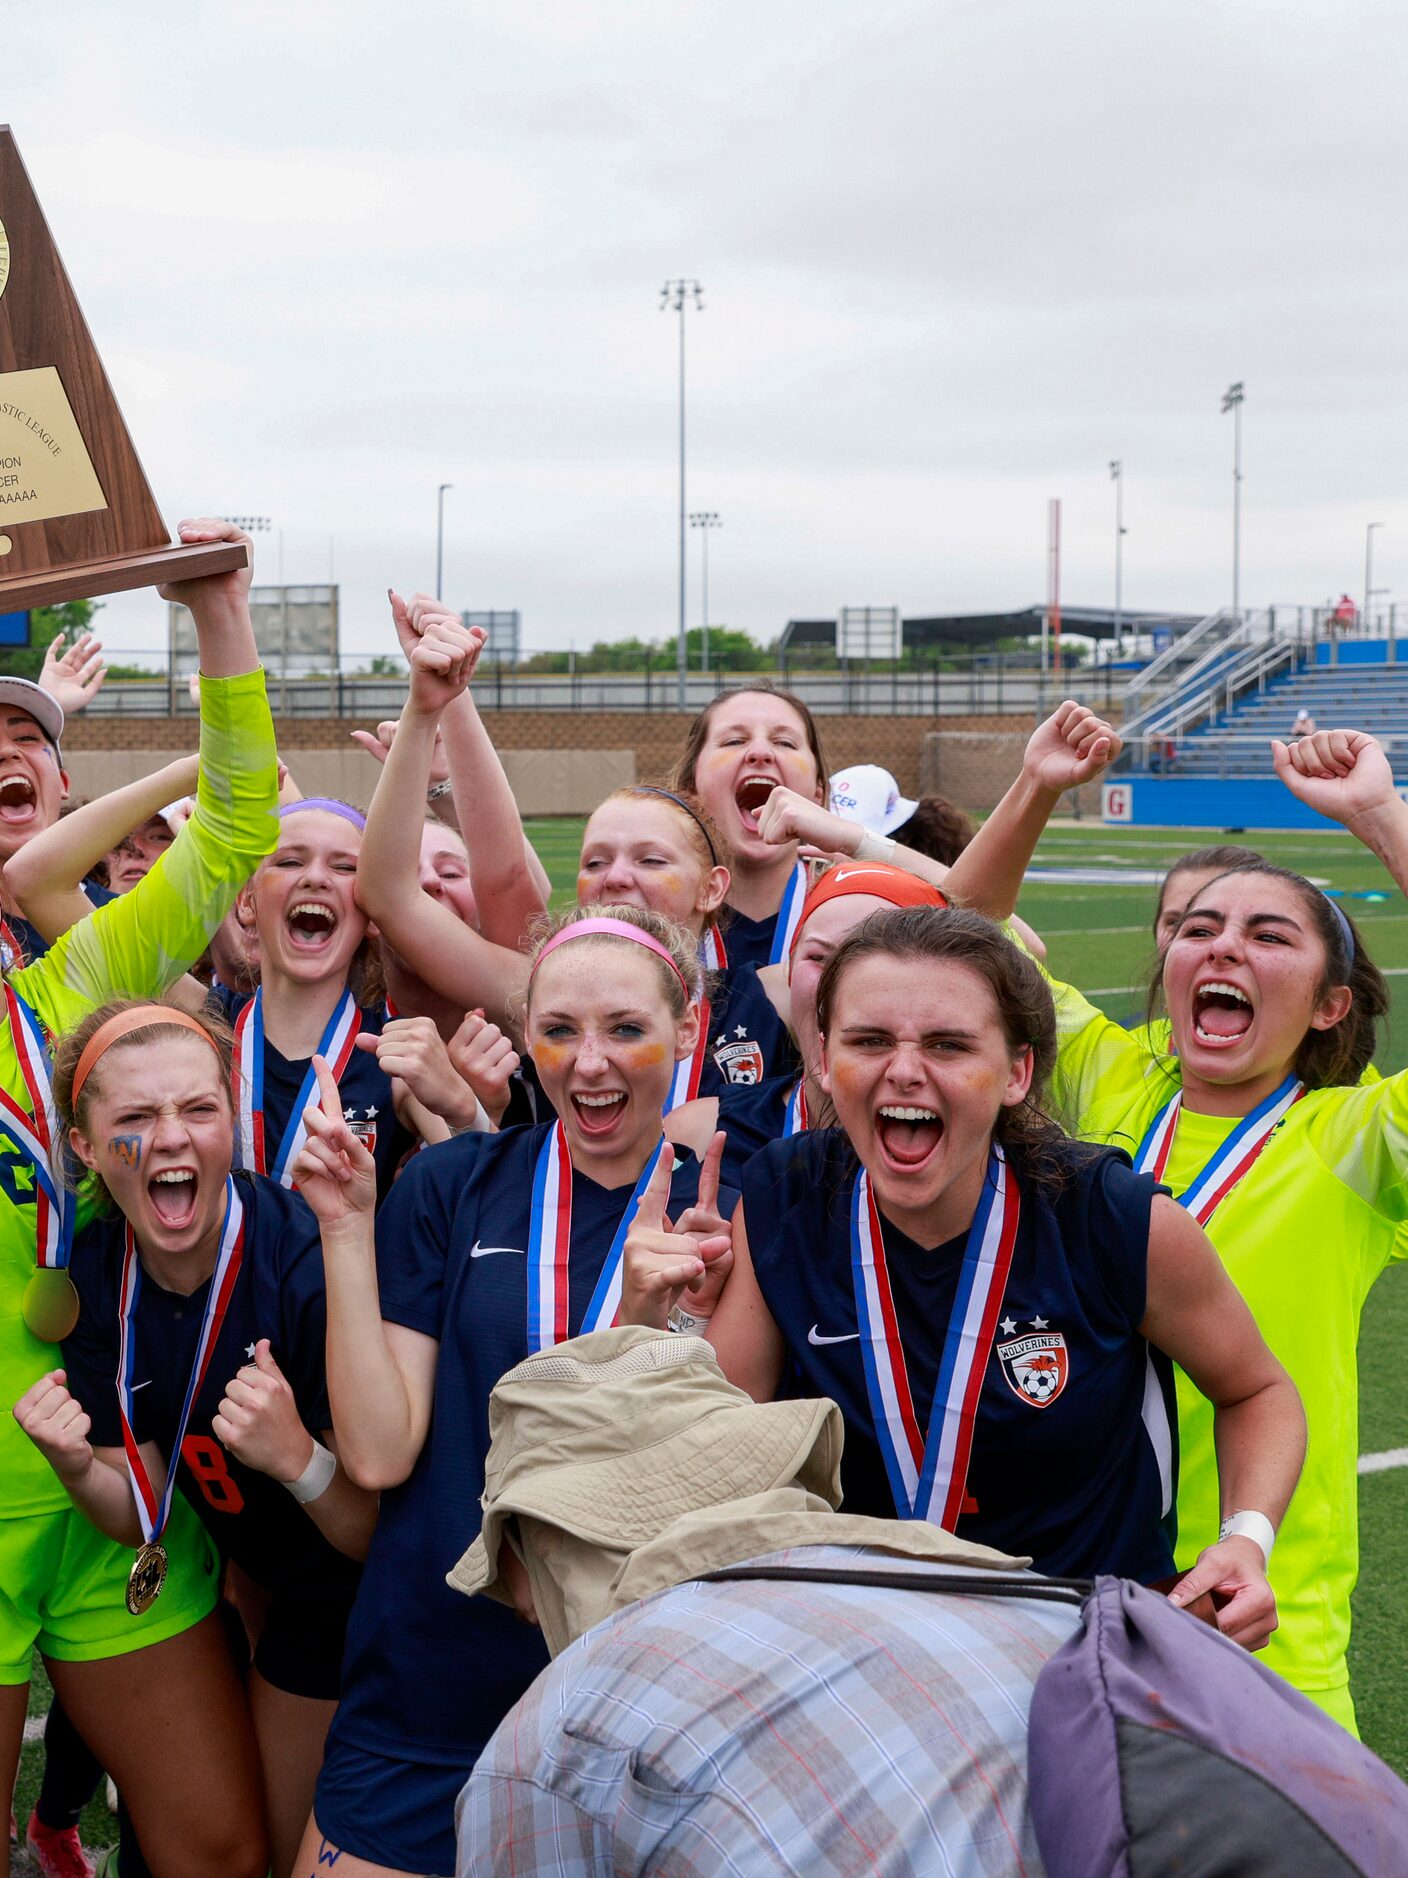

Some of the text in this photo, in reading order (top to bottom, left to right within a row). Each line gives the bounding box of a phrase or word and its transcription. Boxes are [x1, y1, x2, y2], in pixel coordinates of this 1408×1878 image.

[25, 416, 62, 457] LEAGUE
[1108, 788, 1124, 816] G
[1000, 1337, 1060, 1359] WOLVERINES
[182, 1434, 245, 1515] 8
